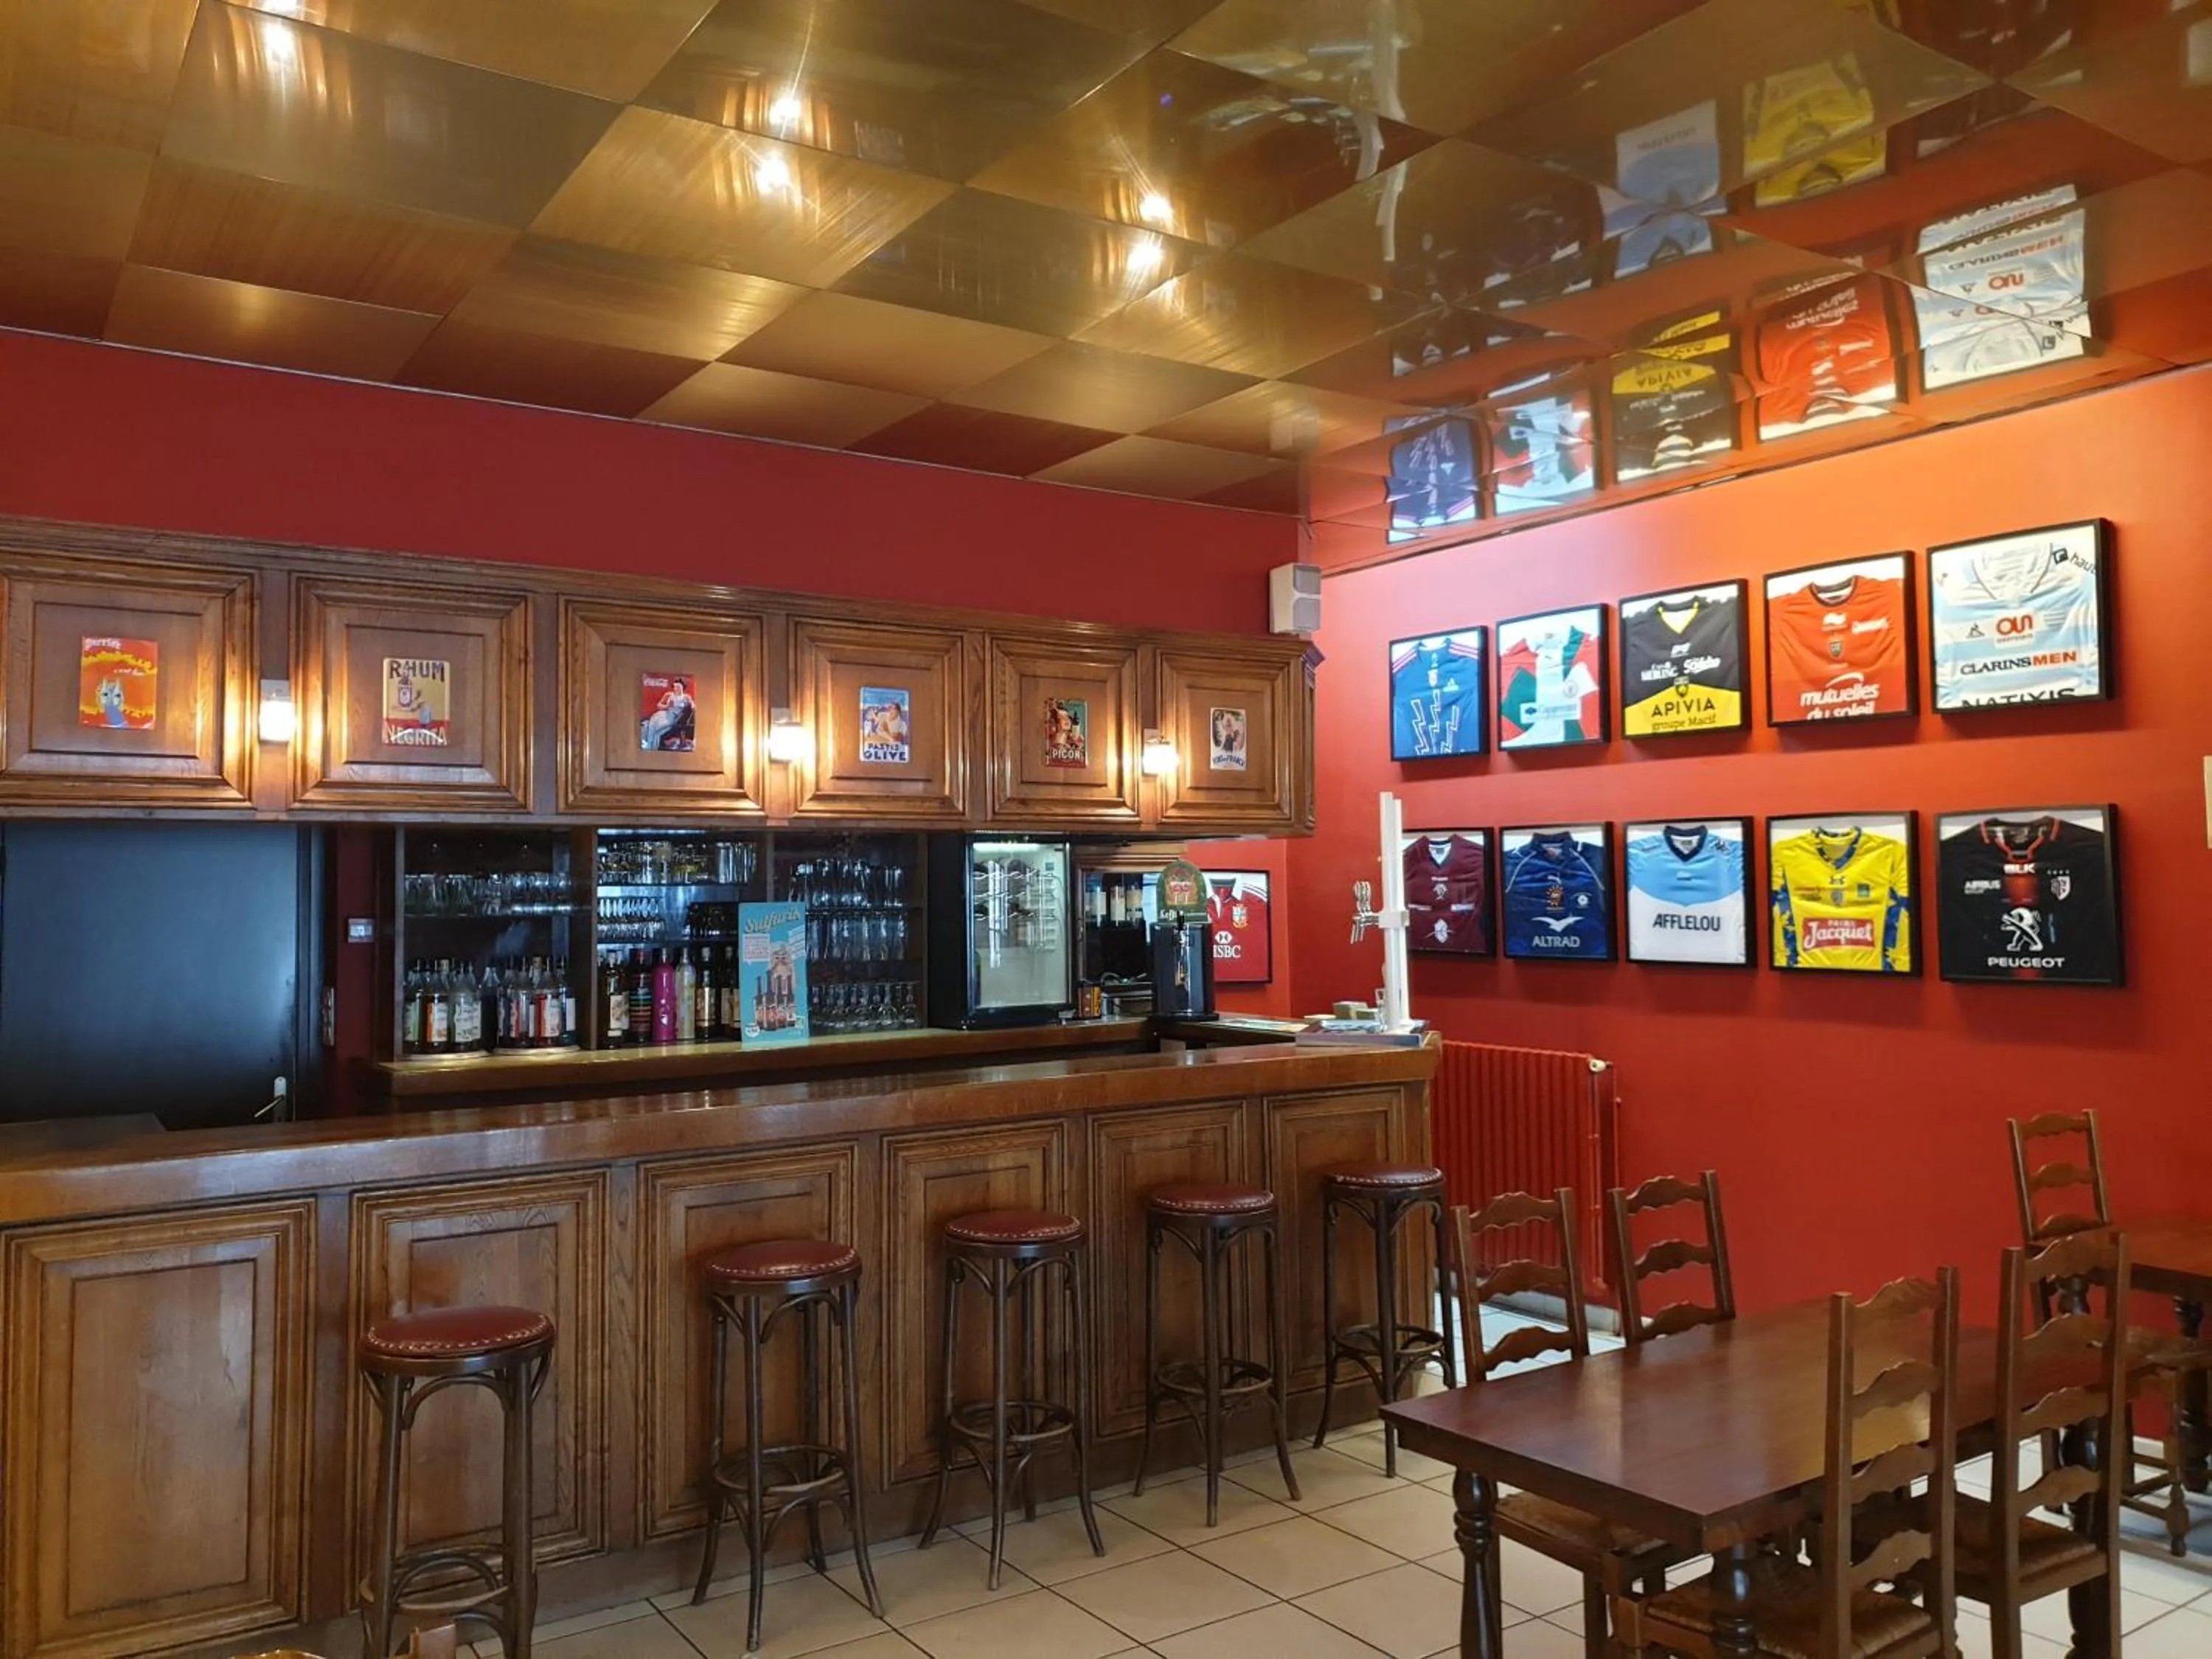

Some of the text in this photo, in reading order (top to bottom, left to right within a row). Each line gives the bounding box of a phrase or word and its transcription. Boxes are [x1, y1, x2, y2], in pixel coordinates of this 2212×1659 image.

[389, 659, 445, 684] RHUM
[1800, 684, 1880, 707] mutuelles
[1651, 697, 1717, 718] APIVIA
[863, 750, 907, 762] OLIVE
[1652, 913, 1721, 932] AFFLELOU
[1532, 935, 1581, 948] ALTRAD
[1804, 921, 1873, 949] Jacquet
[1987, 956, 2065, 968] PEUGEOT
